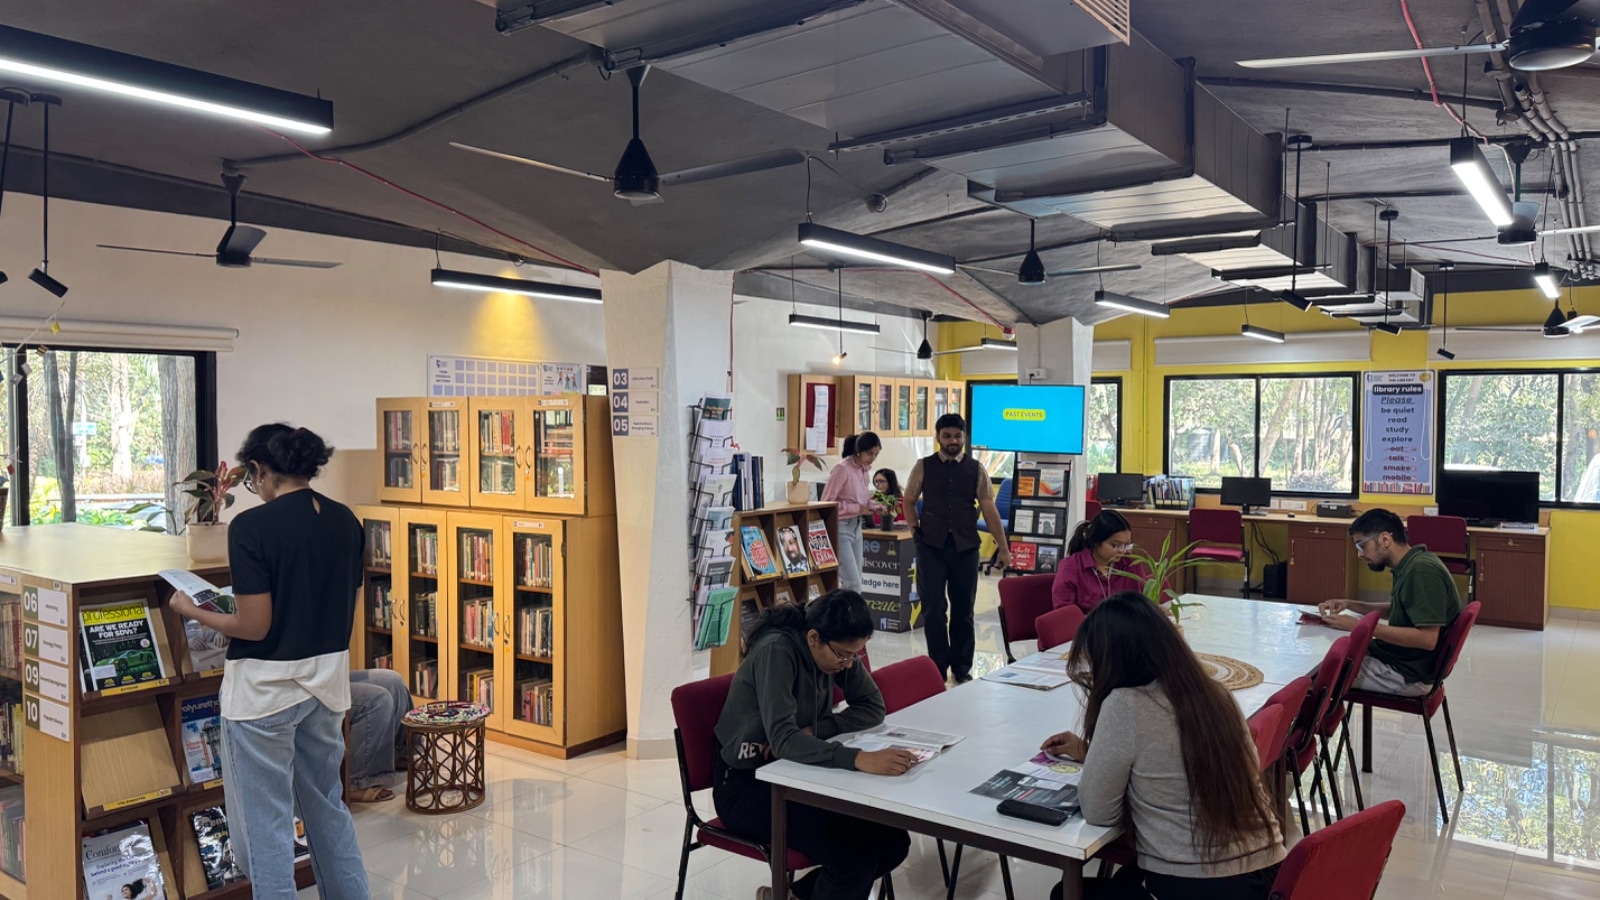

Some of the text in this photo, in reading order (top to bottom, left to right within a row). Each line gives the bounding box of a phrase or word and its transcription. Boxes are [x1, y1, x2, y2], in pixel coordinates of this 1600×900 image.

[613, 372, 628, 385] 03
[1373, 385, 1400, 394] library
[613, 395, 628, 409] 04
[1392, 407, 1415, 415] quiet
[613, 418, 628, 432] 05
[1385, 426, 1409, 434] study
[861, 578, 900, 589] ledge here
[23, 592, 38, 612] 06
[866, 599, 901, 612] reate
[82, 603, 145, 621] professional
[89, 620, 144, 633] ARE WE READY
[25, 627, 38, 649] 07
[98, 630, 114, 639] FOR
[25, 664, 39, 685] 09
[26, 701, 38, 722] 10
[182, 700, 220, 713] olyuretha
[86, 845, 120, 859] Comfor
